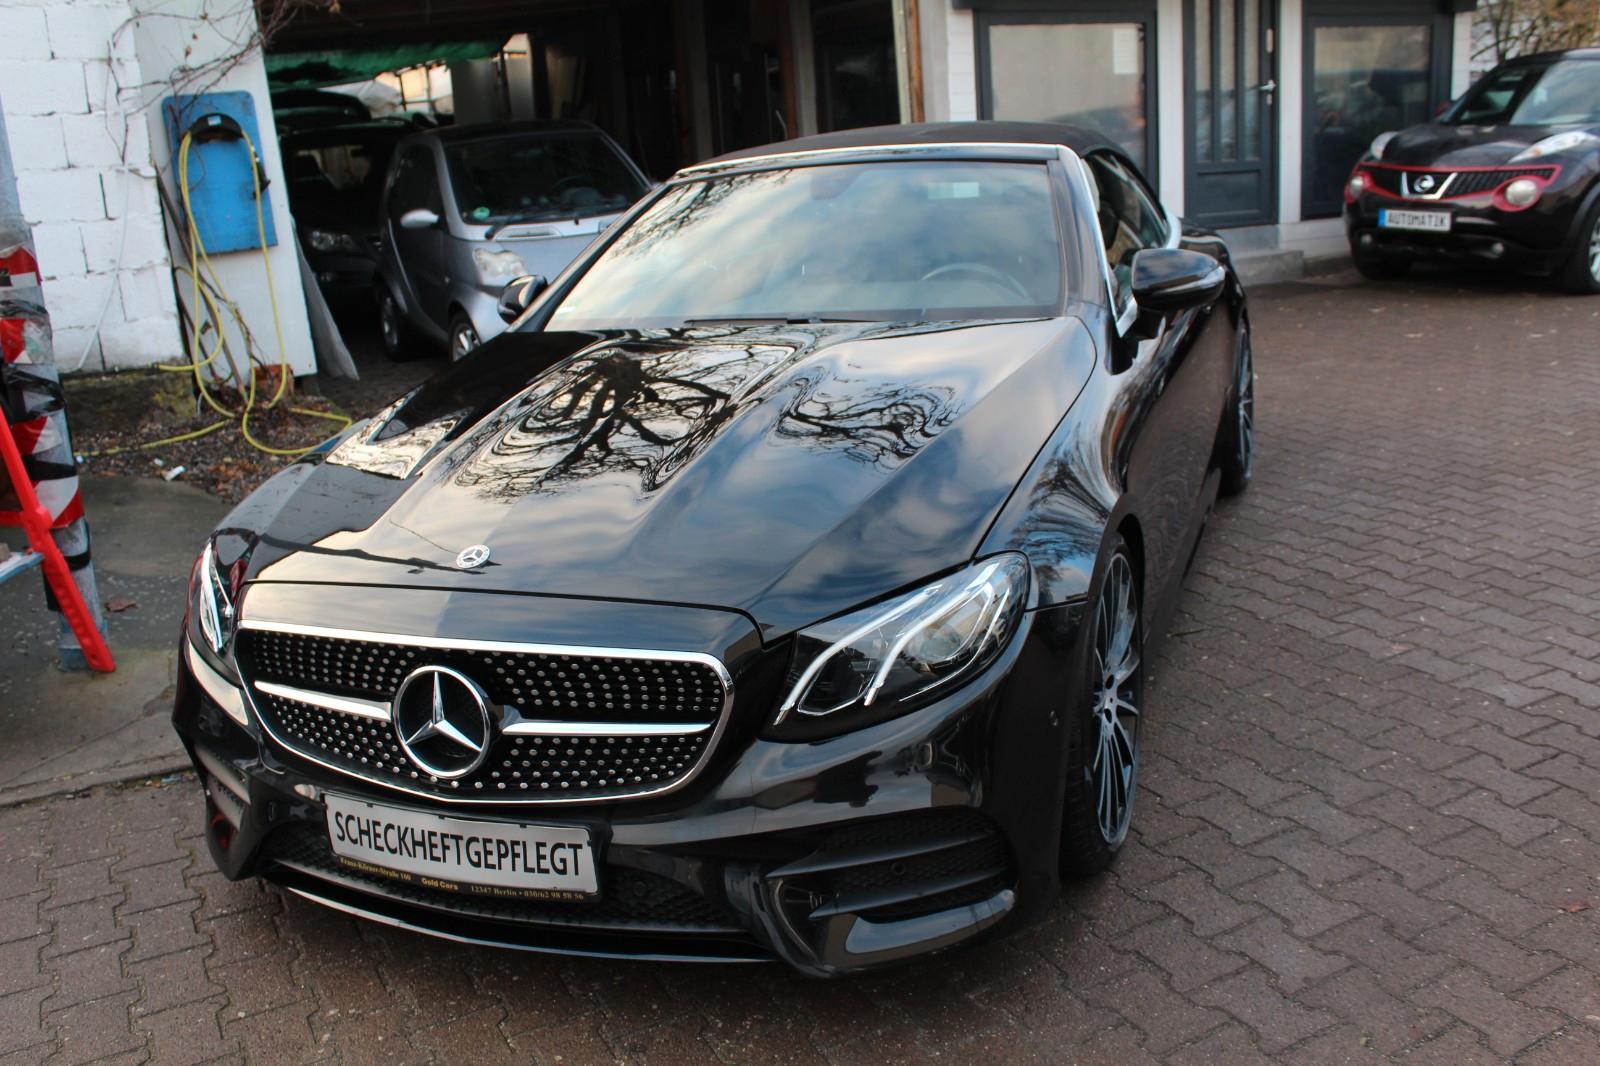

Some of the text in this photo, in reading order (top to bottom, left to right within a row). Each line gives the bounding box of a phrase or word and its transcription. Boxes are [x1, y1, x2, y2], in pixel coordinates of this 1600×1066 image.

[1387, 213, 1447, 228] AUTOMATIK
[335, 811, 583, 876] SCHECKHEFTGEPFLEGT
[421, 877, 459, 891] Gold Cars
[470, 885, 492, 894] 12347
[494, 888, 517, 897] Berlin
